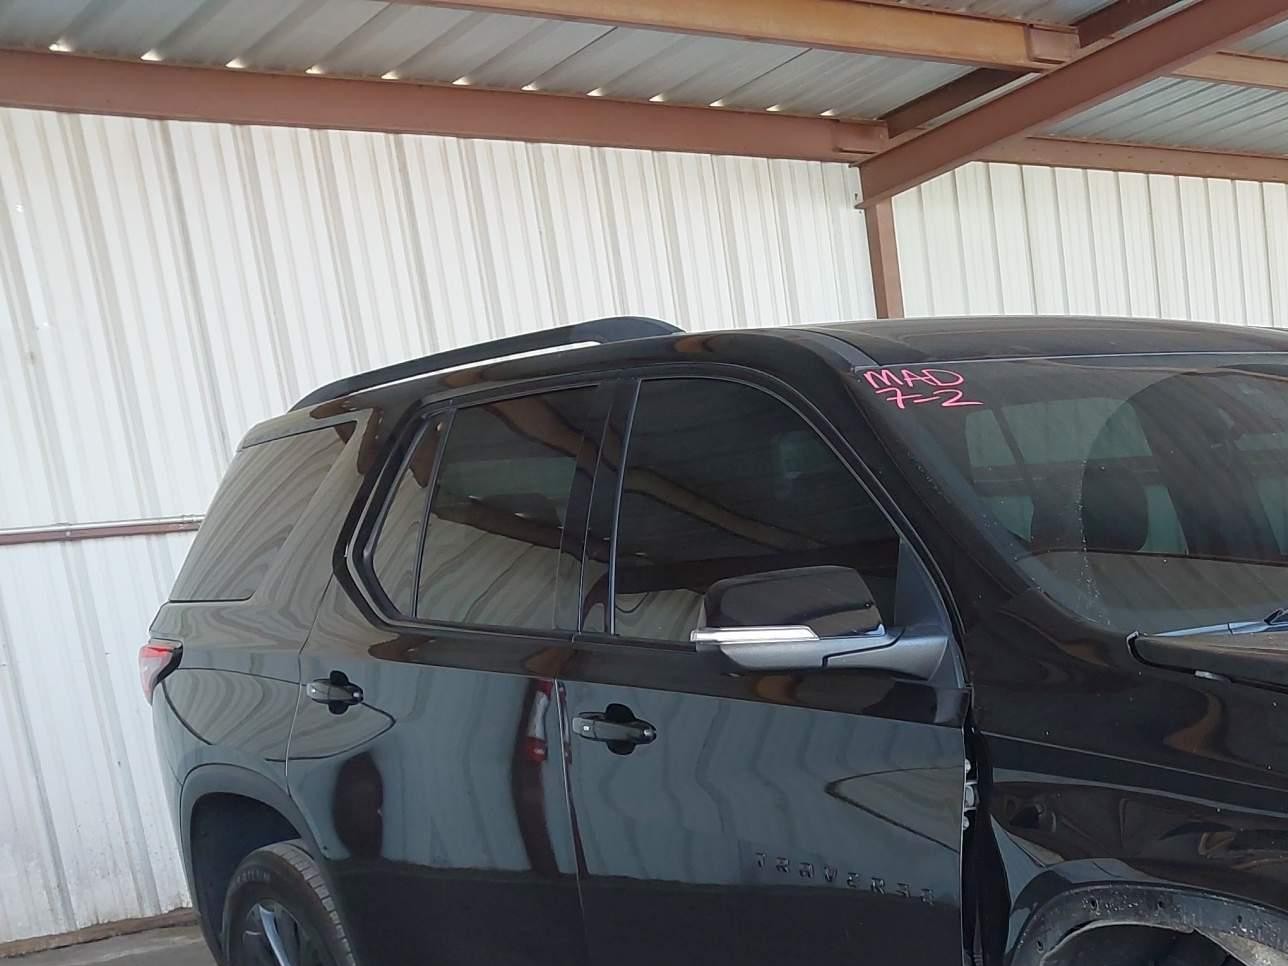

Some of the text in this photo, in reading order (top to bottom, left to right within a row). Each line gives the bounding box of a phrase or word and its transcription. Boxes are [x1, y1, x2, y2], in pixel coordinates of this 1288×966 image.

[863, 368, 965, 389] MAD
[875, 387, 985, 410] 7-2
[755, 852, 936, 905] TRAVERSE
